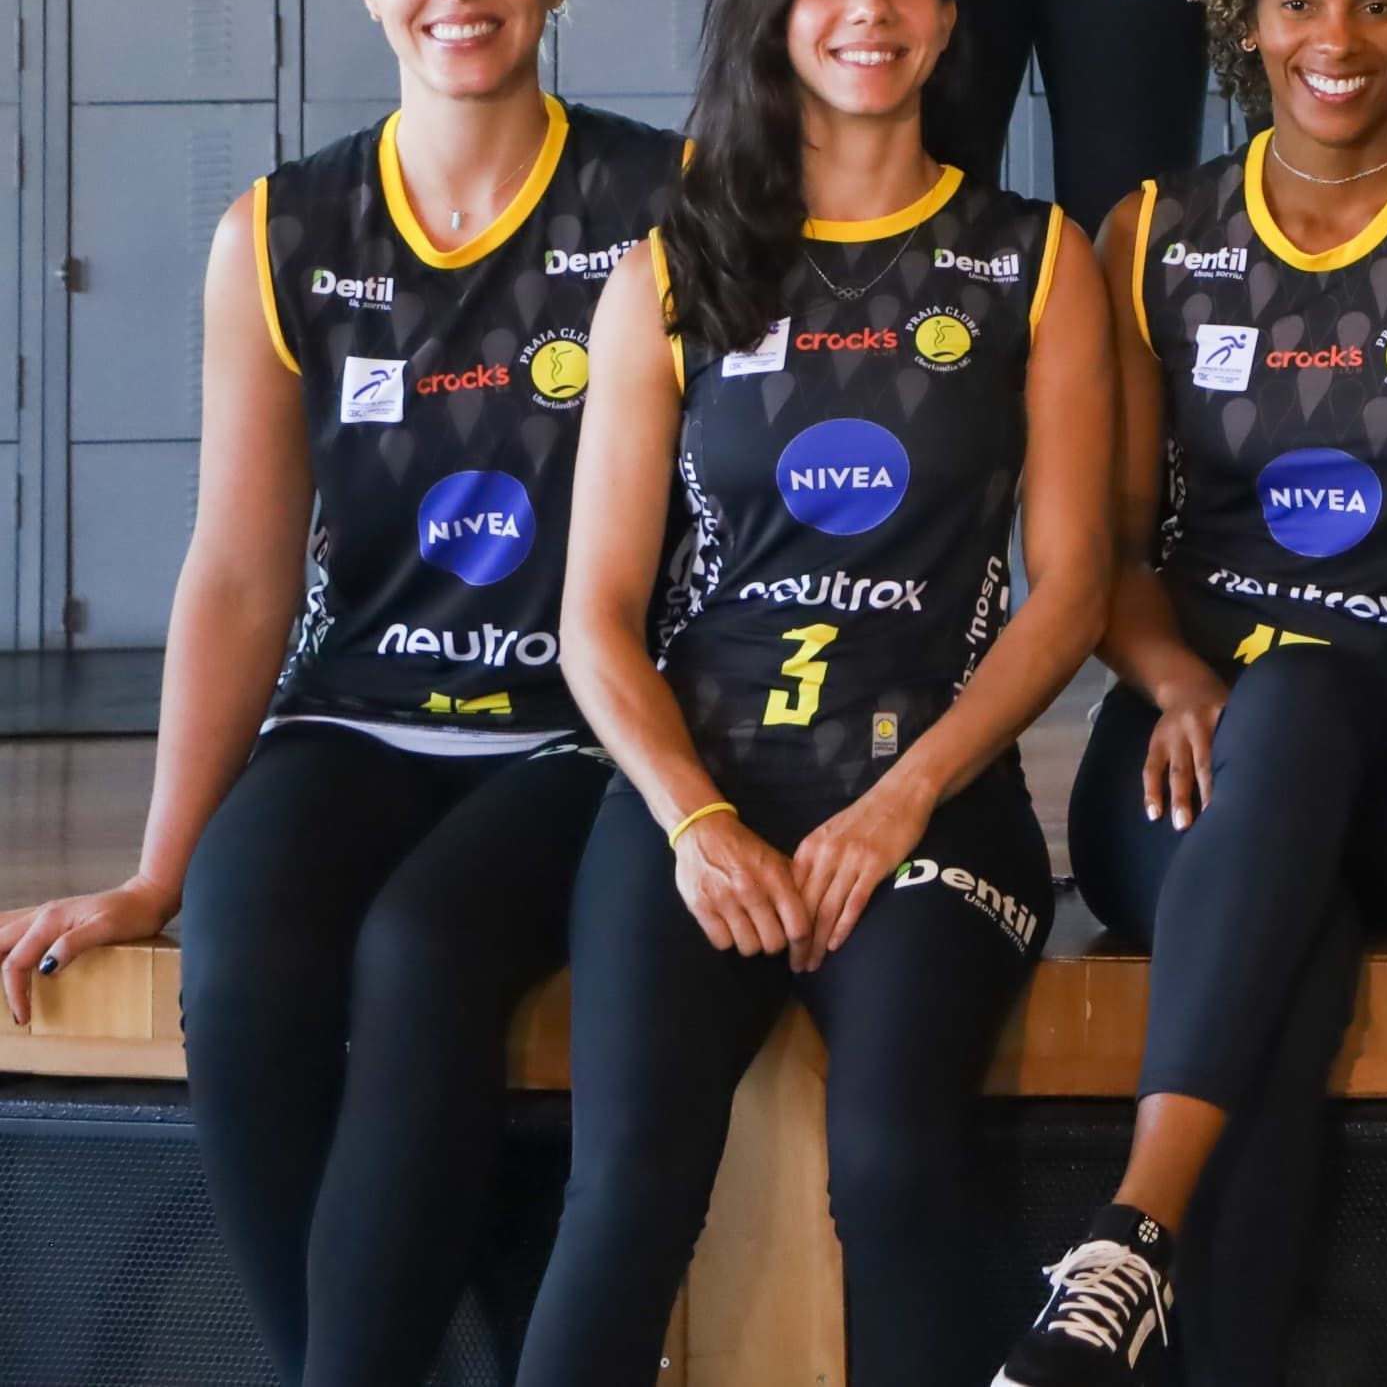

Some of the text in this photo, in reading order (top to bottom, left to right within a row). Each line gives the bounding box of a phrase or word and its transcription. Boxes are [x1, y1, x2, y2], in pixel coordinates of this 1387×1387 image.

[935, 248, 1019, 276] Dentil
[1162, 242, 1247, 272] Dentil
[311, 269, 394, 302] Dentil
[905, 306, 981, 339] PRAIA CLUBE
[519, 329, 556, 365] PRAIA
[790, 466, 893, 491] NIVEA
[1270, 487, 1366, 515] NIVEA
[428, 512, 520, 544] NIVEA
[378, 623, 559, 667] neutro
[762, 623, 839, 727] 3
[893, 858, 1038, 946] Dentil
